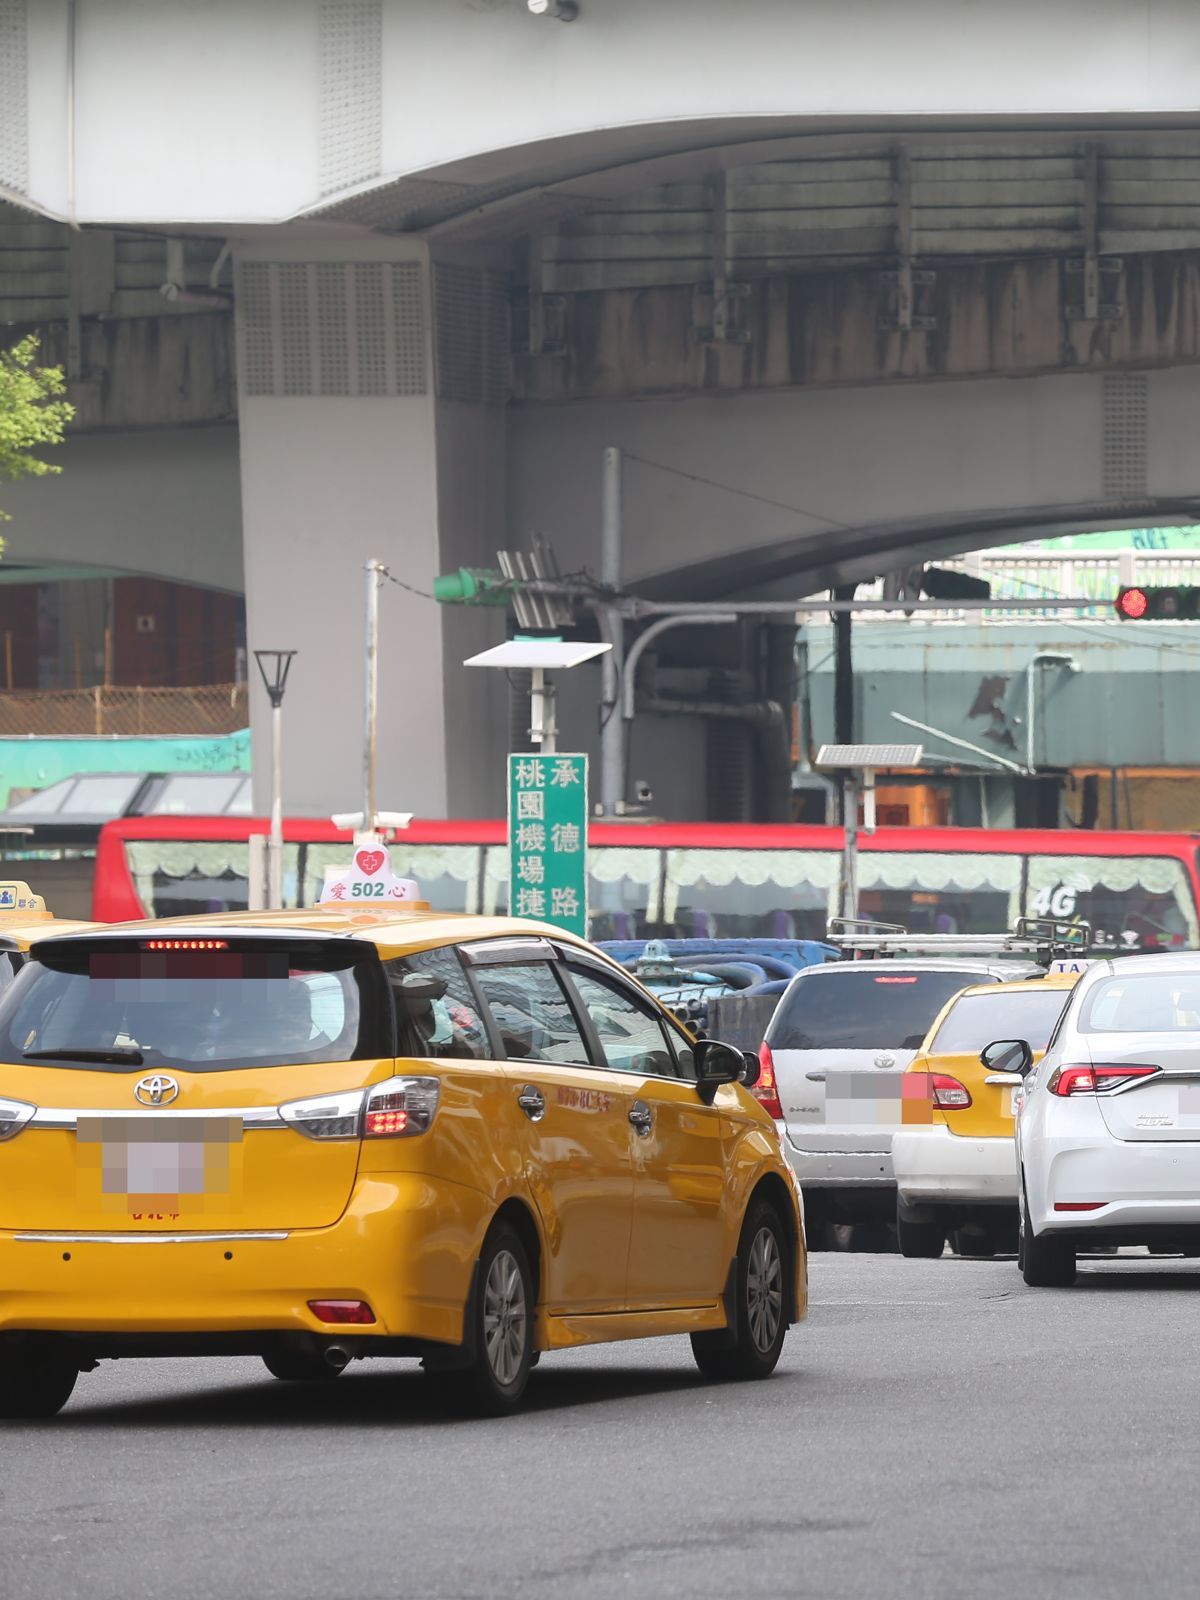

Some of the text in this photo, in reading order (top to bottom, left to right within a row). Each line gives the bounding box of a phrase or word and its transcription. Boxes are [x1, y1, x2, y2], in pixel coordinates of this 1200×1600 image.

[515, 759, 546, 918] 桃園機場捷
[550, 759, 580, 917] 承德路
[351, 883, 385, 897] 502
[1031, 886, 1078, 917] 4G
